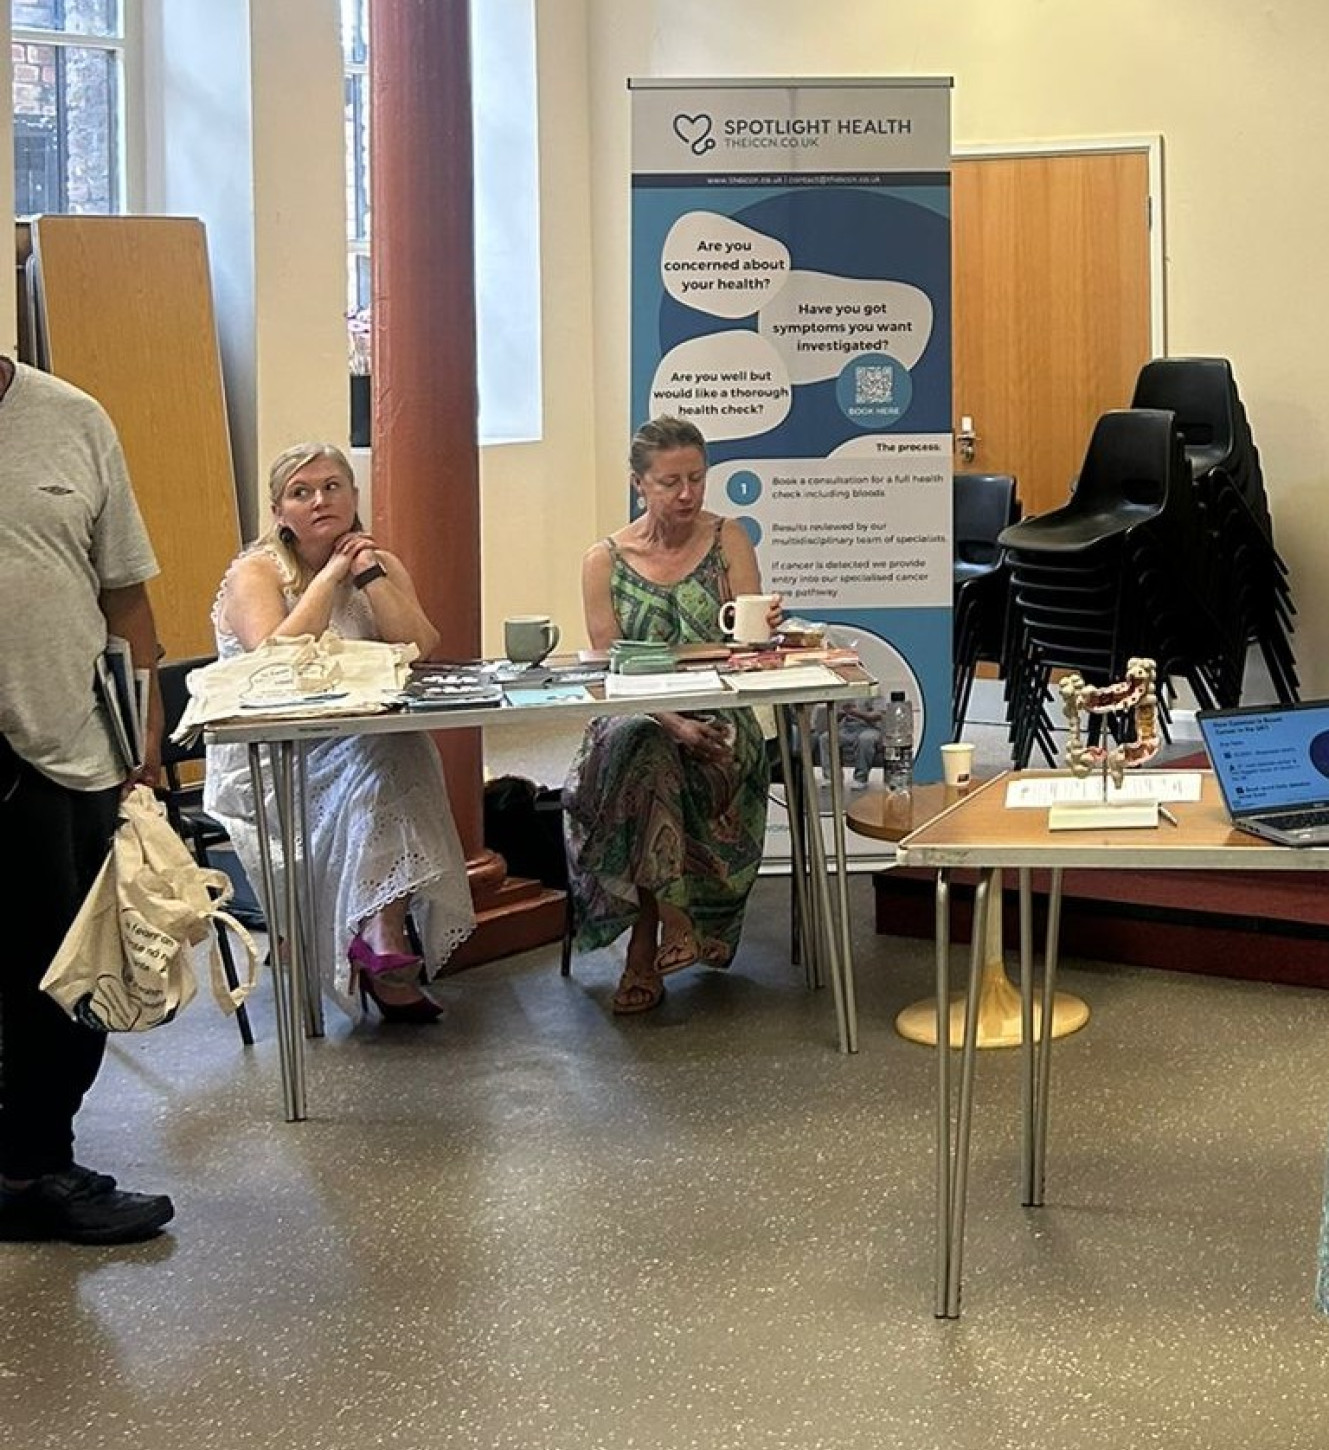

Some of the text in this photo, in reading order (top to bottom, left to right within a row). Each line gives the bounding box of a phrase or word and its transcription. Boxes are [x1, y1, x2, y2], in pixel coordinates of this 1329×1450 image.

[724, 119, 911, 135] SPOTLIGHT HEALTH
[726, 137, 819, 148] THEICCN.CO.UK
[697, 241, 751, 254] Are you
[664, 260, 785, 271] concerned about
[682, 279, 771, 293] your health?
[798, 304, 887, 317] Have you got
[772, 322, 912, 335] symptoms you want
[797, 339, 889, 353] investigated?
[671, 371, 771, 384] Are you well but
[654, 387, 789, 400] would like a thorough
[678, 404, 764, 415] health check?
[876, 442, 895, 452] The
[772, 474, 944, 486] Book a consultation for a full health
[740, 483, 747, 495] 1
[772, 490, 885, 500] check including bloods
[772, 523, 807, 532] Results
[809, 523, 853, 531] reviewed
[856, 523, 868, 533] by
[772, 536, 854, 546] multidisciplinary
[856, 536, 882, 544] team
[884, 535, 895, 543] of
[780, 561, 814, 570] cancer
[816, 561, 823, 569] is
[825, 560, 870, 569] detected
[889, 560, 926, 569] provide
[772, 576, 797, 585] entry
[799, 575, 819, 583] into
[840, 574, 893, 584] specialised
[896, 574, 928, 582] cancer
[795, 588, 838, 598] pathway
